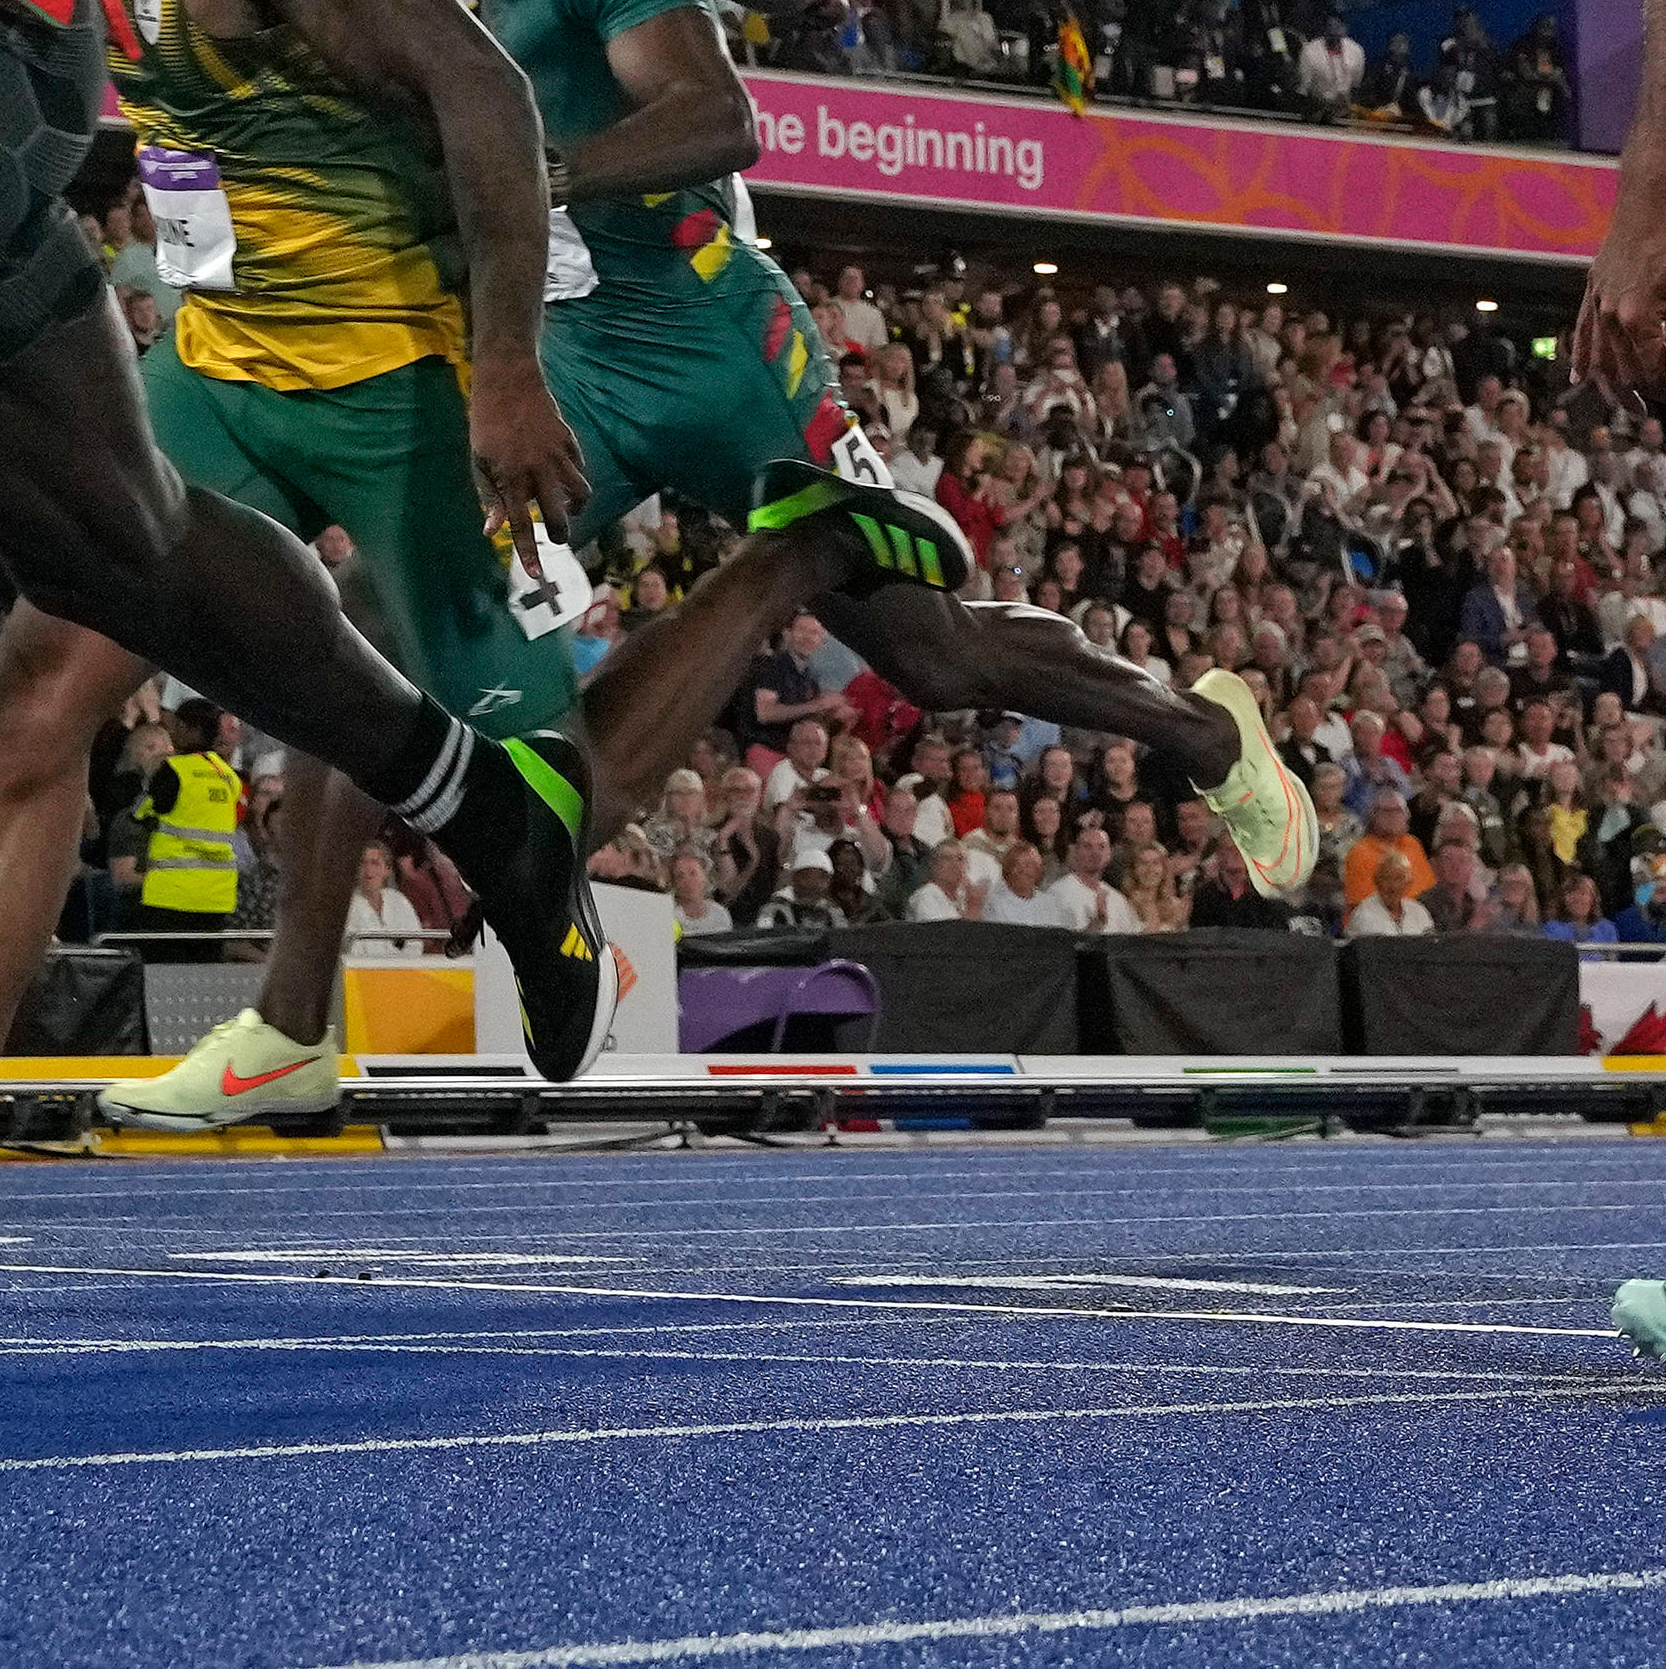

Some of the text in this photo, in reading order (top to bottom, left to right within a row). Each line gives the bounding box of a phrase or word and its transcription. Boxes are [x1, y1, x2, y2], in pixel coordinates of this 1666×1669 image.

[753, 97, 1045, 191] he beginning
[845, 434, 880, 485] 5
